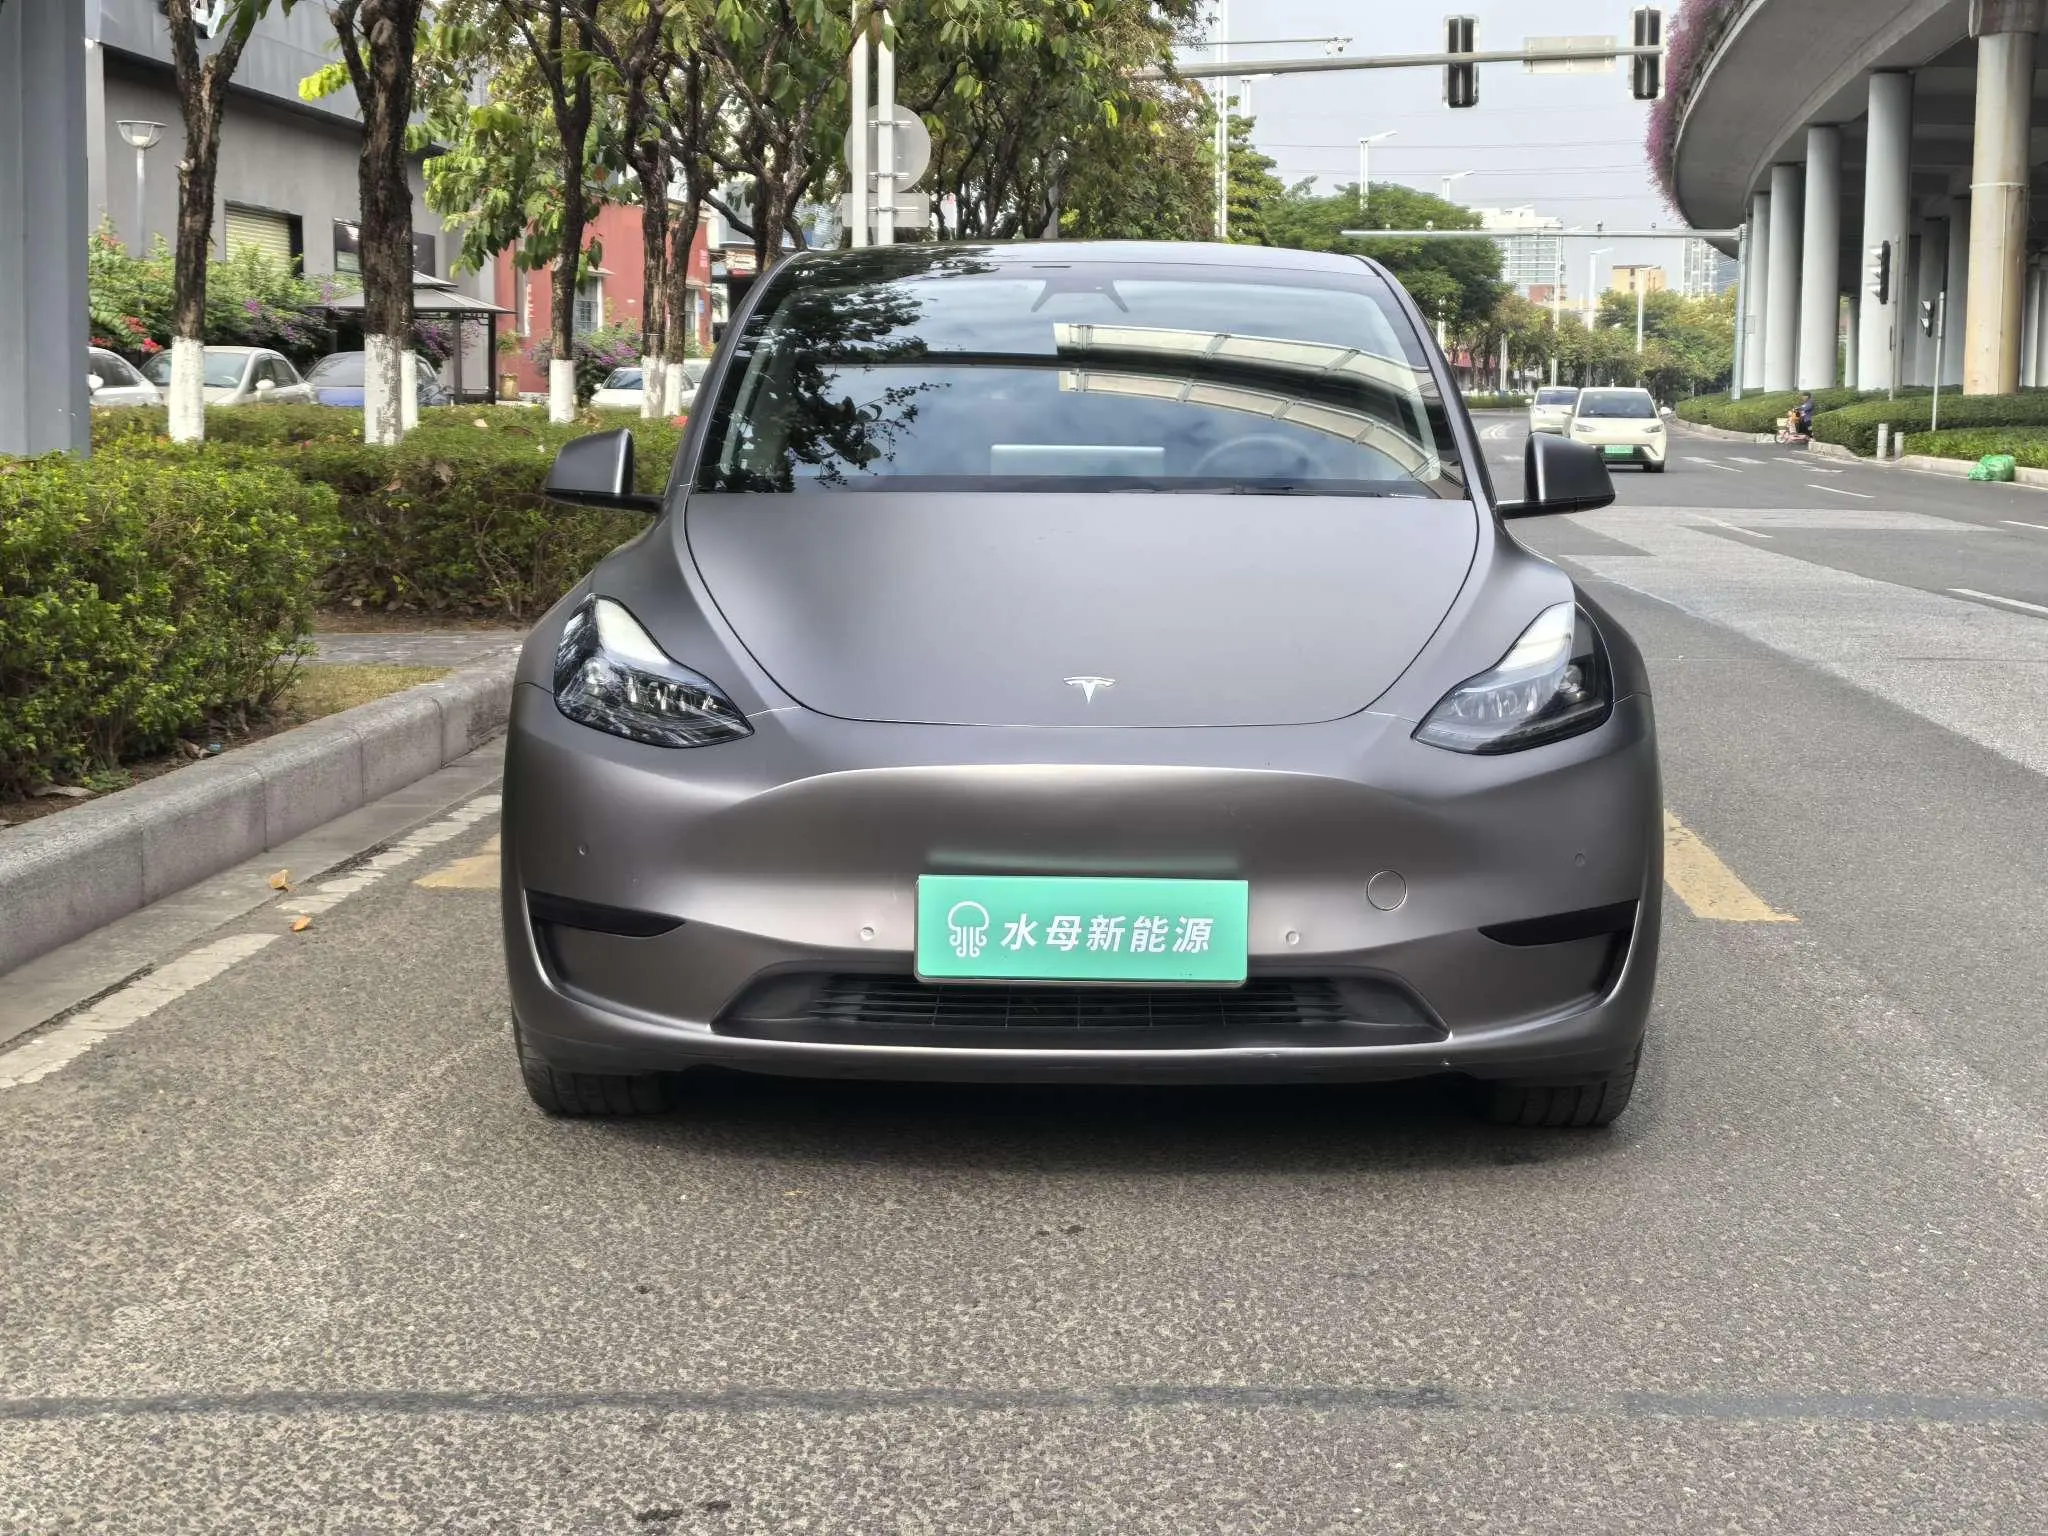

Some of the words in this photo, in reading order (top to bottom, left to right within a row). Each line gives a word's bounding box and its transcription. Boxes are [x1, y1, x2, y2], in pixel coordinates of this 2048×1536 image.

[1000, 913, 1214, 954] 水母新能源
